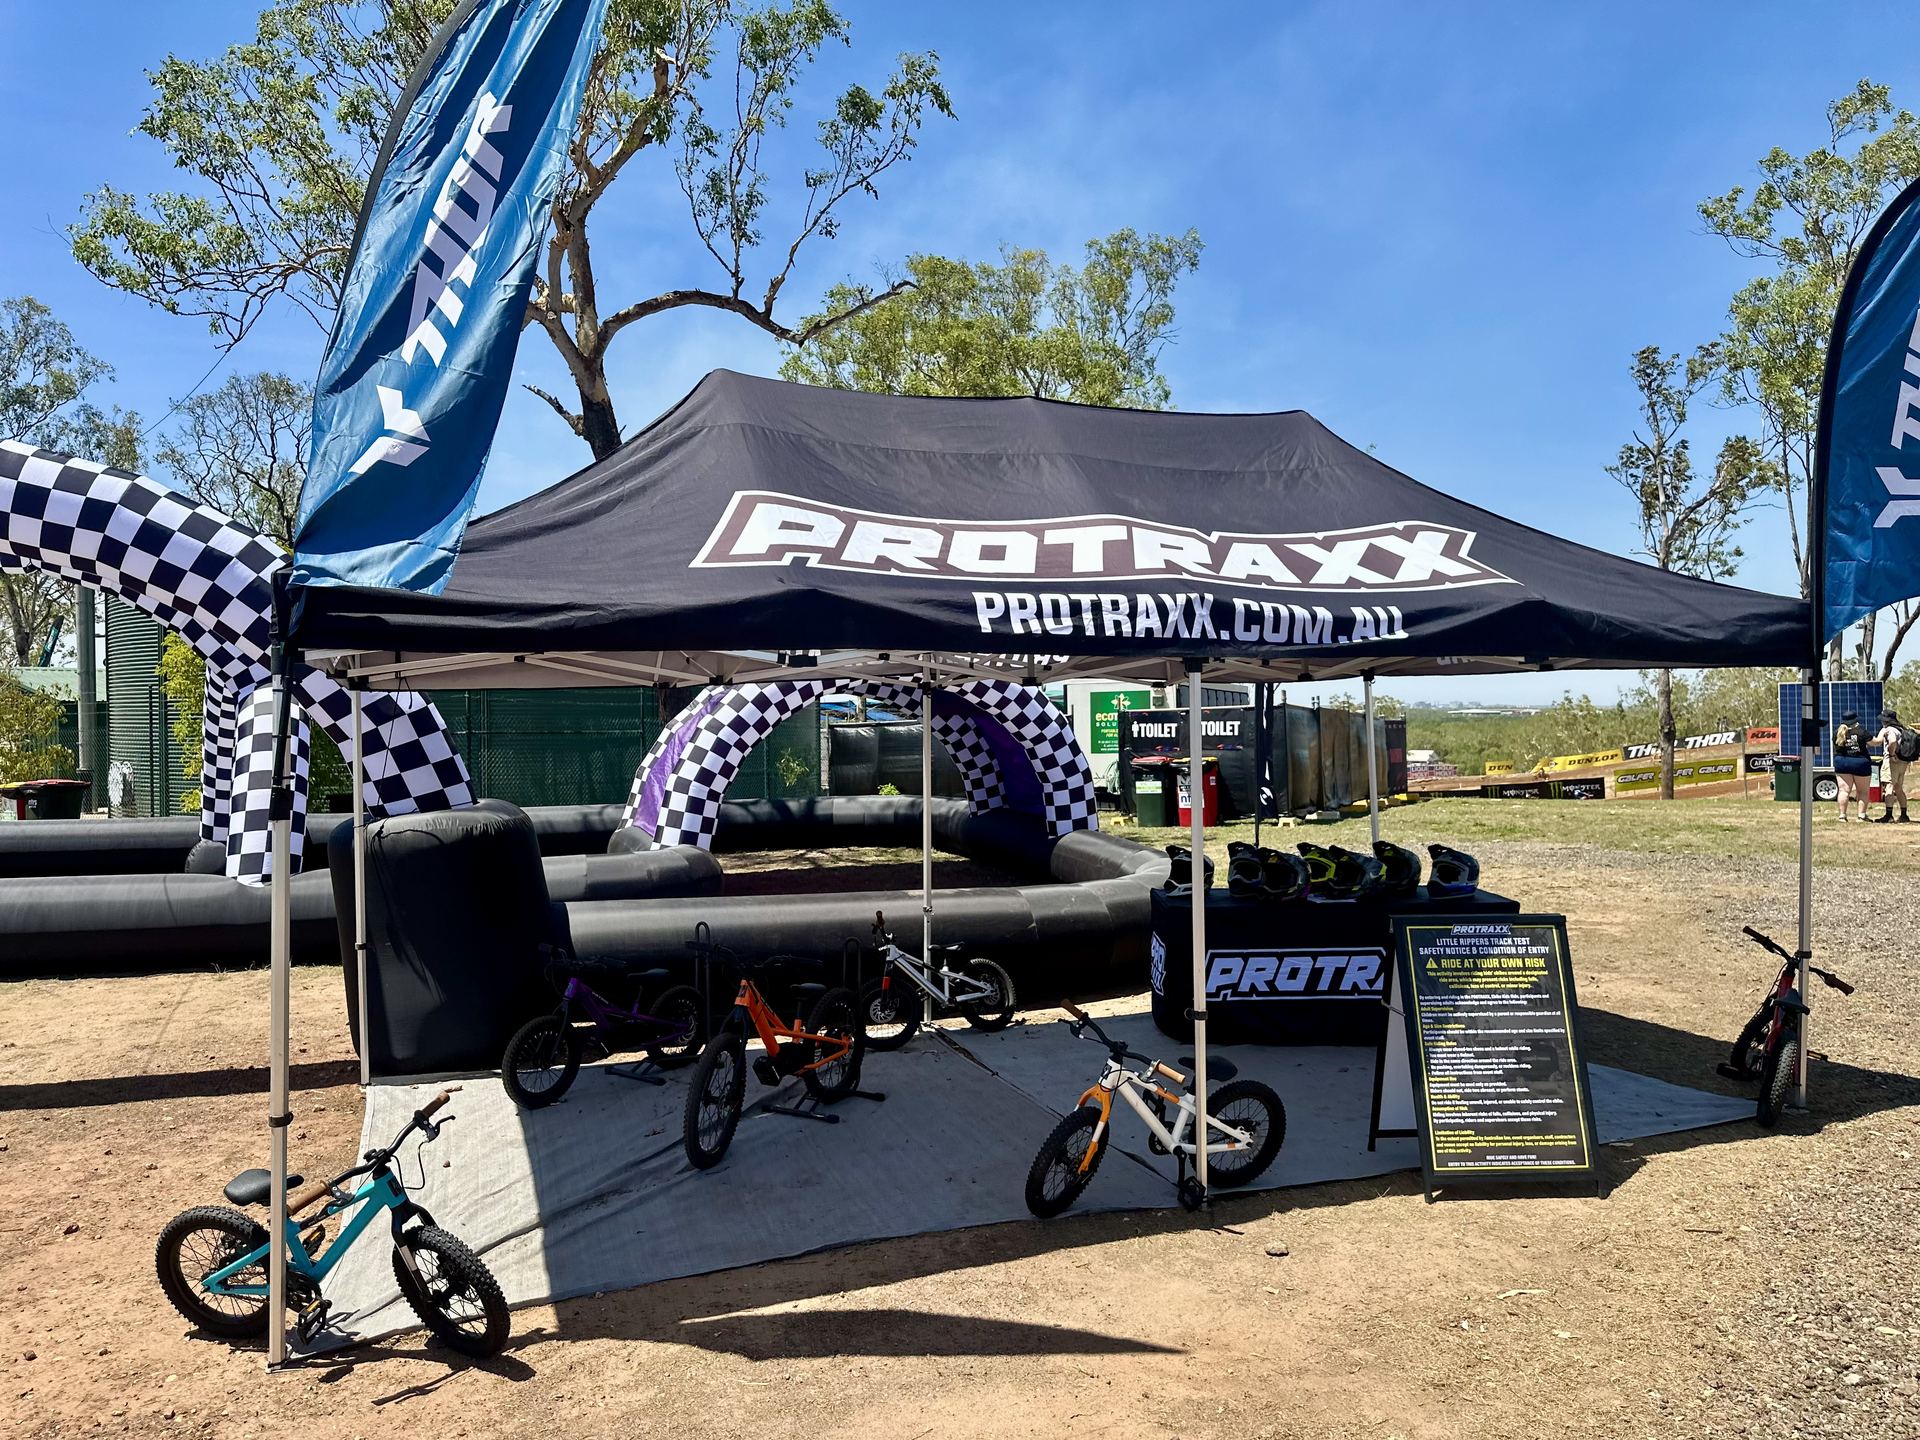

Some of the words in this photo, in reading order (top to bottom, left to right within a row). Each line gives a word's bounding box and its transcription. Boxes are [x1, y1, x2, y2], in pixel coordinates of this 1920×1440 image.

[401, 91, 513, 367] THOR
[728, 500, 1480, 585] PROTRAXX
[973, 591, 1409, 646] PROTRAXX.COM.AU
[1139, 723, 1178, 738] TOILET
[1201, 721, 1240, 736] TOILET
[1751, 730, 1777, 739] KTM
[1685, 731, 1736, 750] THOR
[1568, 753, 1619, 767] DUNLOP
[1452, 924, 1511, 935] PROTRAXX
[1440, 959, 1462, 968] RIDE
[1462, 958, 1475, 968] AT
[1475, 958, 1500, 968] YOUR
[1500, 958, 1524, 967] OWN
[1524, 958, 1545, 967] RISK
[1206, 956, 1384, 993] PROTR
